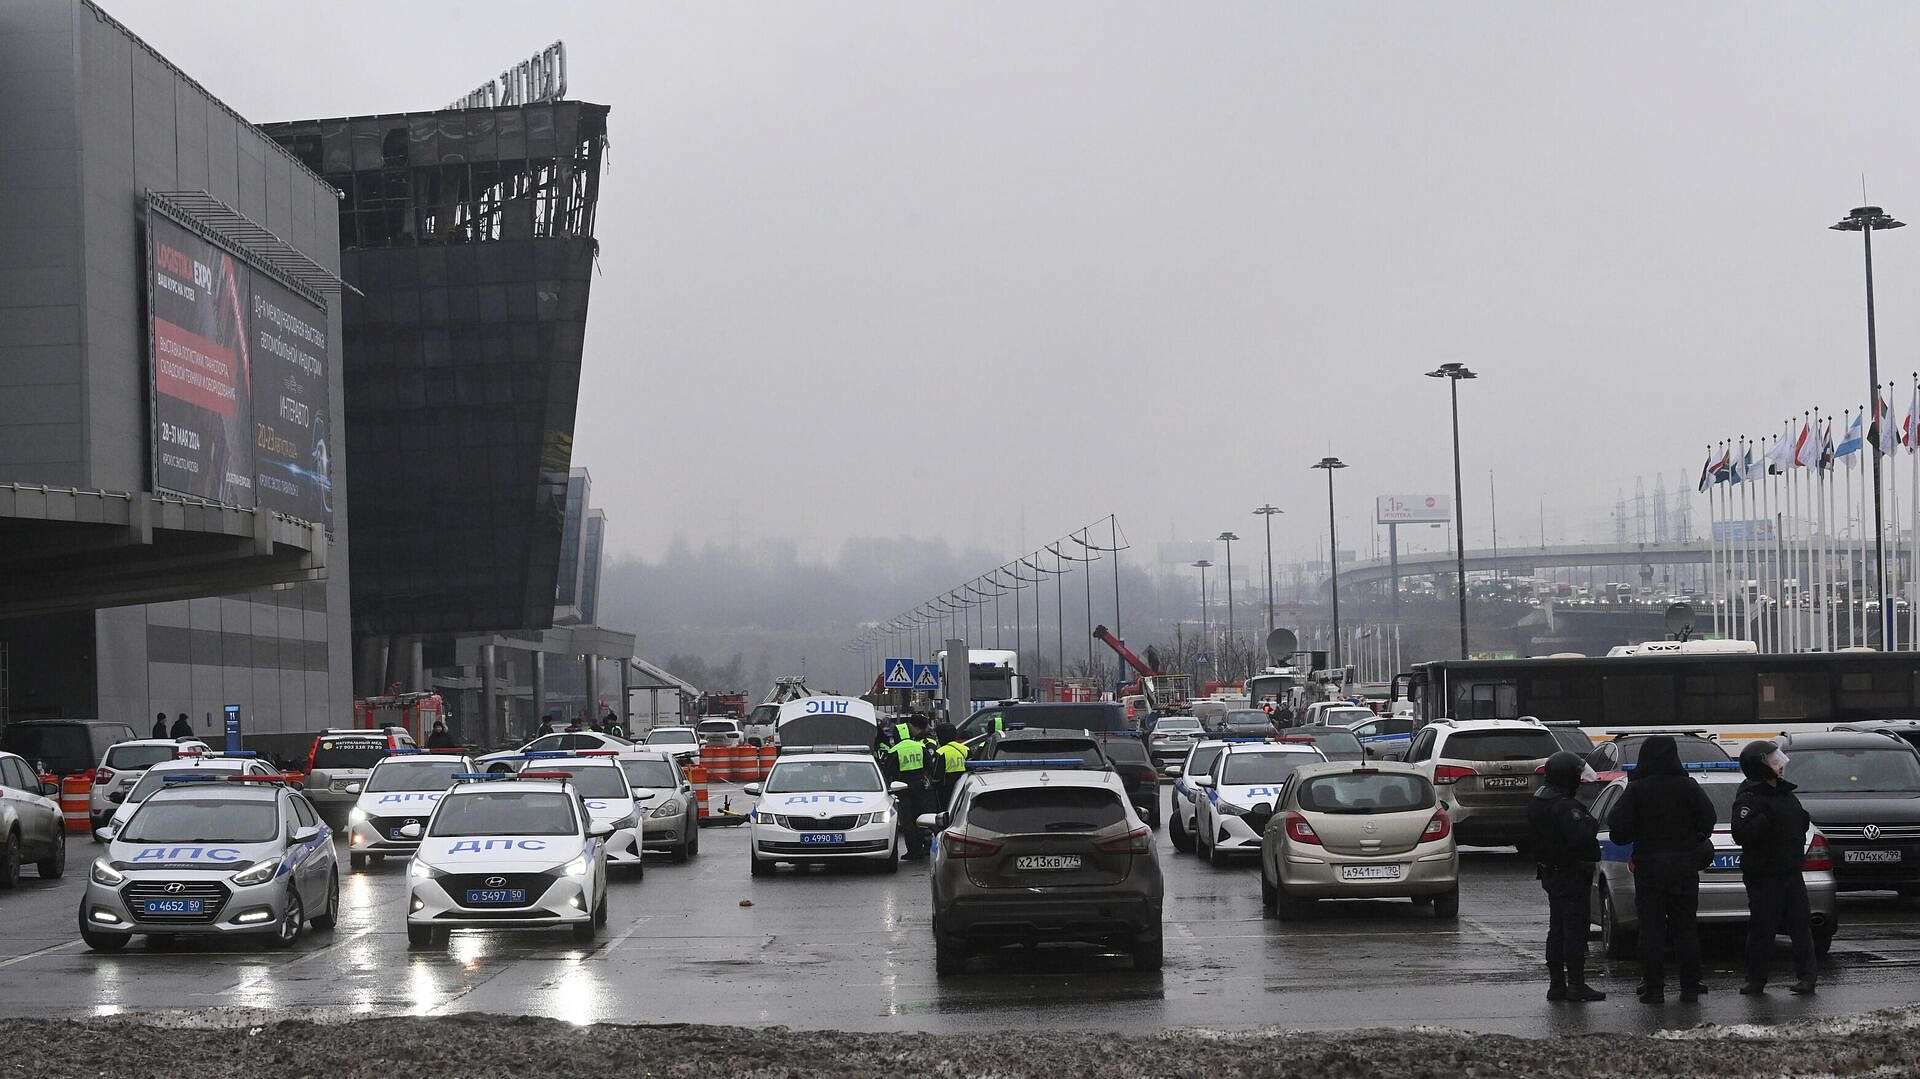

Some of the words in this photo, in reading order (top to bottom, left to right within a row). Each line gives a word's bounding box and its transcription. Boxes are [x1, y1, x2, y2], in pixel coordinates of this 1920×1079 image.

[194, 260, 212, 294] EXPO
[158, 272, 168, 288] ВАШ
[168, 278, 178, 294] КУРС
[178, 283, 183, 296] НА
[280, 393, 309, 428] ИНТЕРАВТО
[177, 428, 188, 446] МАЯ
[806, 701, 848, 713] ДПС
[785, 796, 864, 805] ДПС
[448, 840, 546, 854] ДПС
[133, 848, 240, 861] ДПС
[482, 891, 506, 900] 5497
[160, 902, 183, 911] 4652
